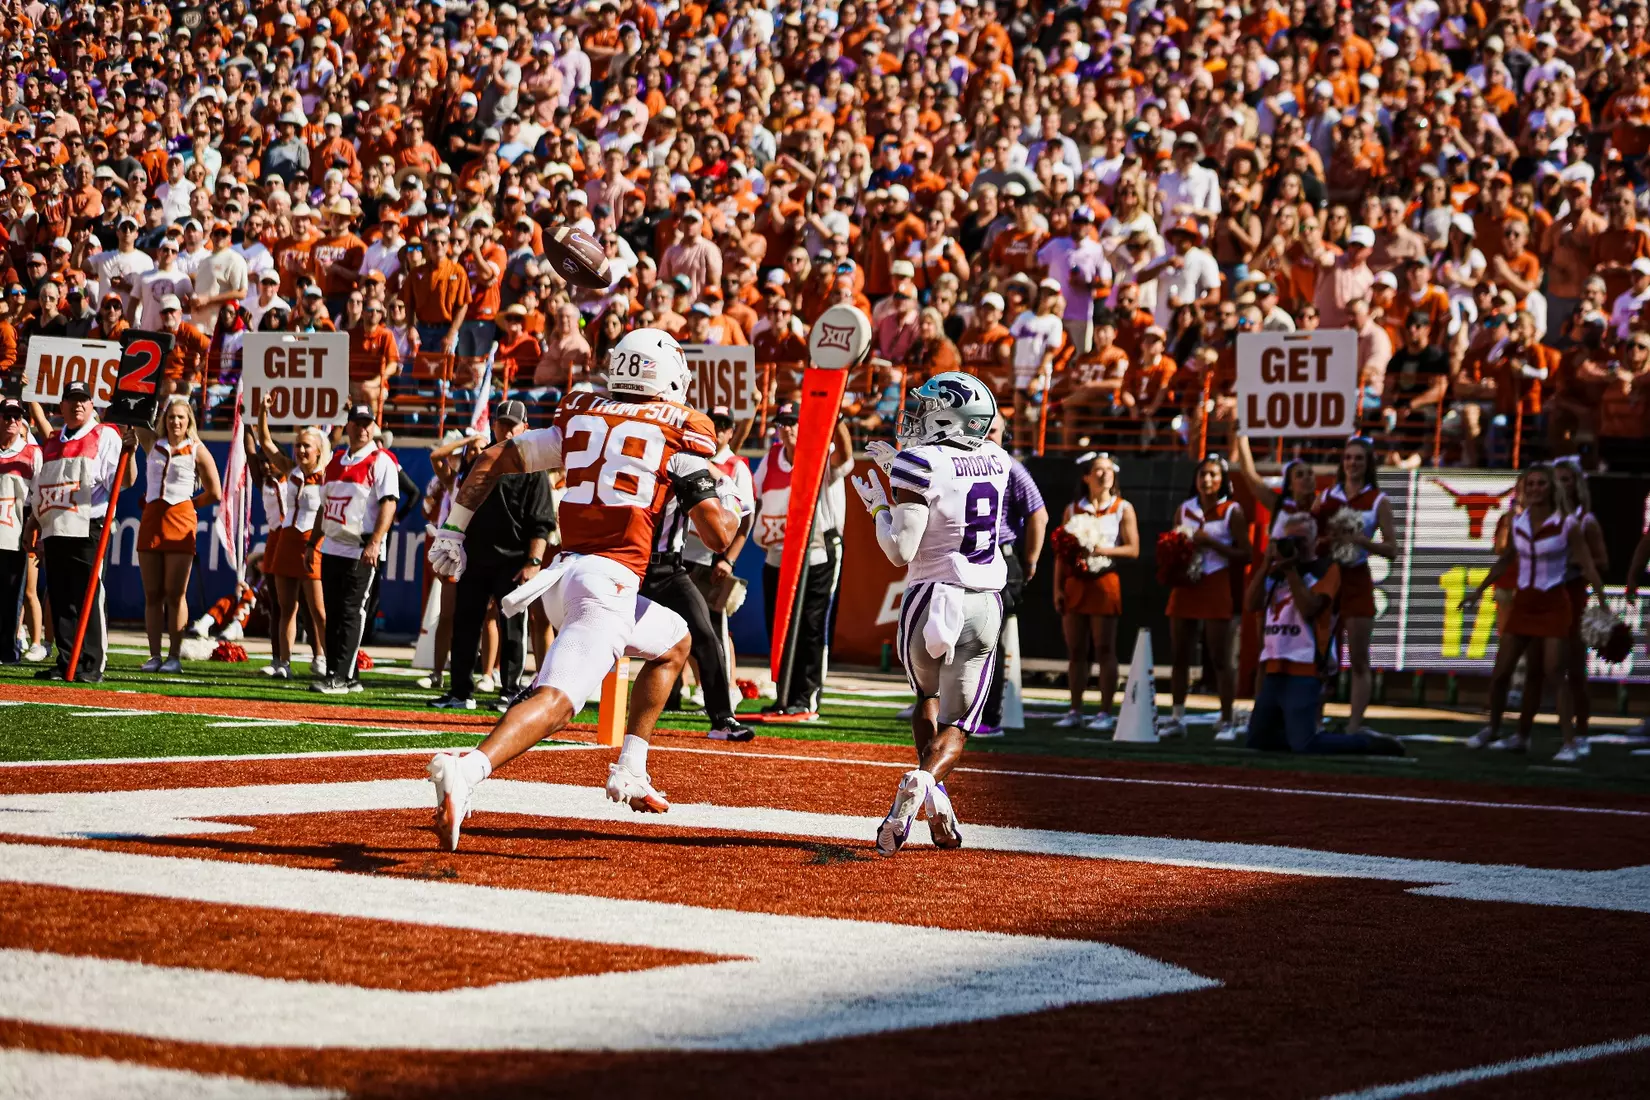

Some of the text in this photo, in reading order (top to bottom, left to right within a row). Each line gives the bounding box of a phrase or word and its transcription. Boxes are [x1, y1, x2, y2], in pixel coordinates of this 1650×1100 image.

[35, 354, 120, 402] NOIS
[118, 339, 162, 394] 2
[264, 346, 328, 379] GET
[613, 352, 641, 377] 28
[1261, 347, 1333, 384] GET
[566, 393, 584, 410] J.
[588, 395, 690, 429] THOMPSON
[1247, 392, 1345, 429] LOUD
[560, 415, 666, 508] 28
[951, 456, 1004, 477] BROOKS
[959, 481, 999, 565] 8
[1440, 566, 1497, 659] 17
